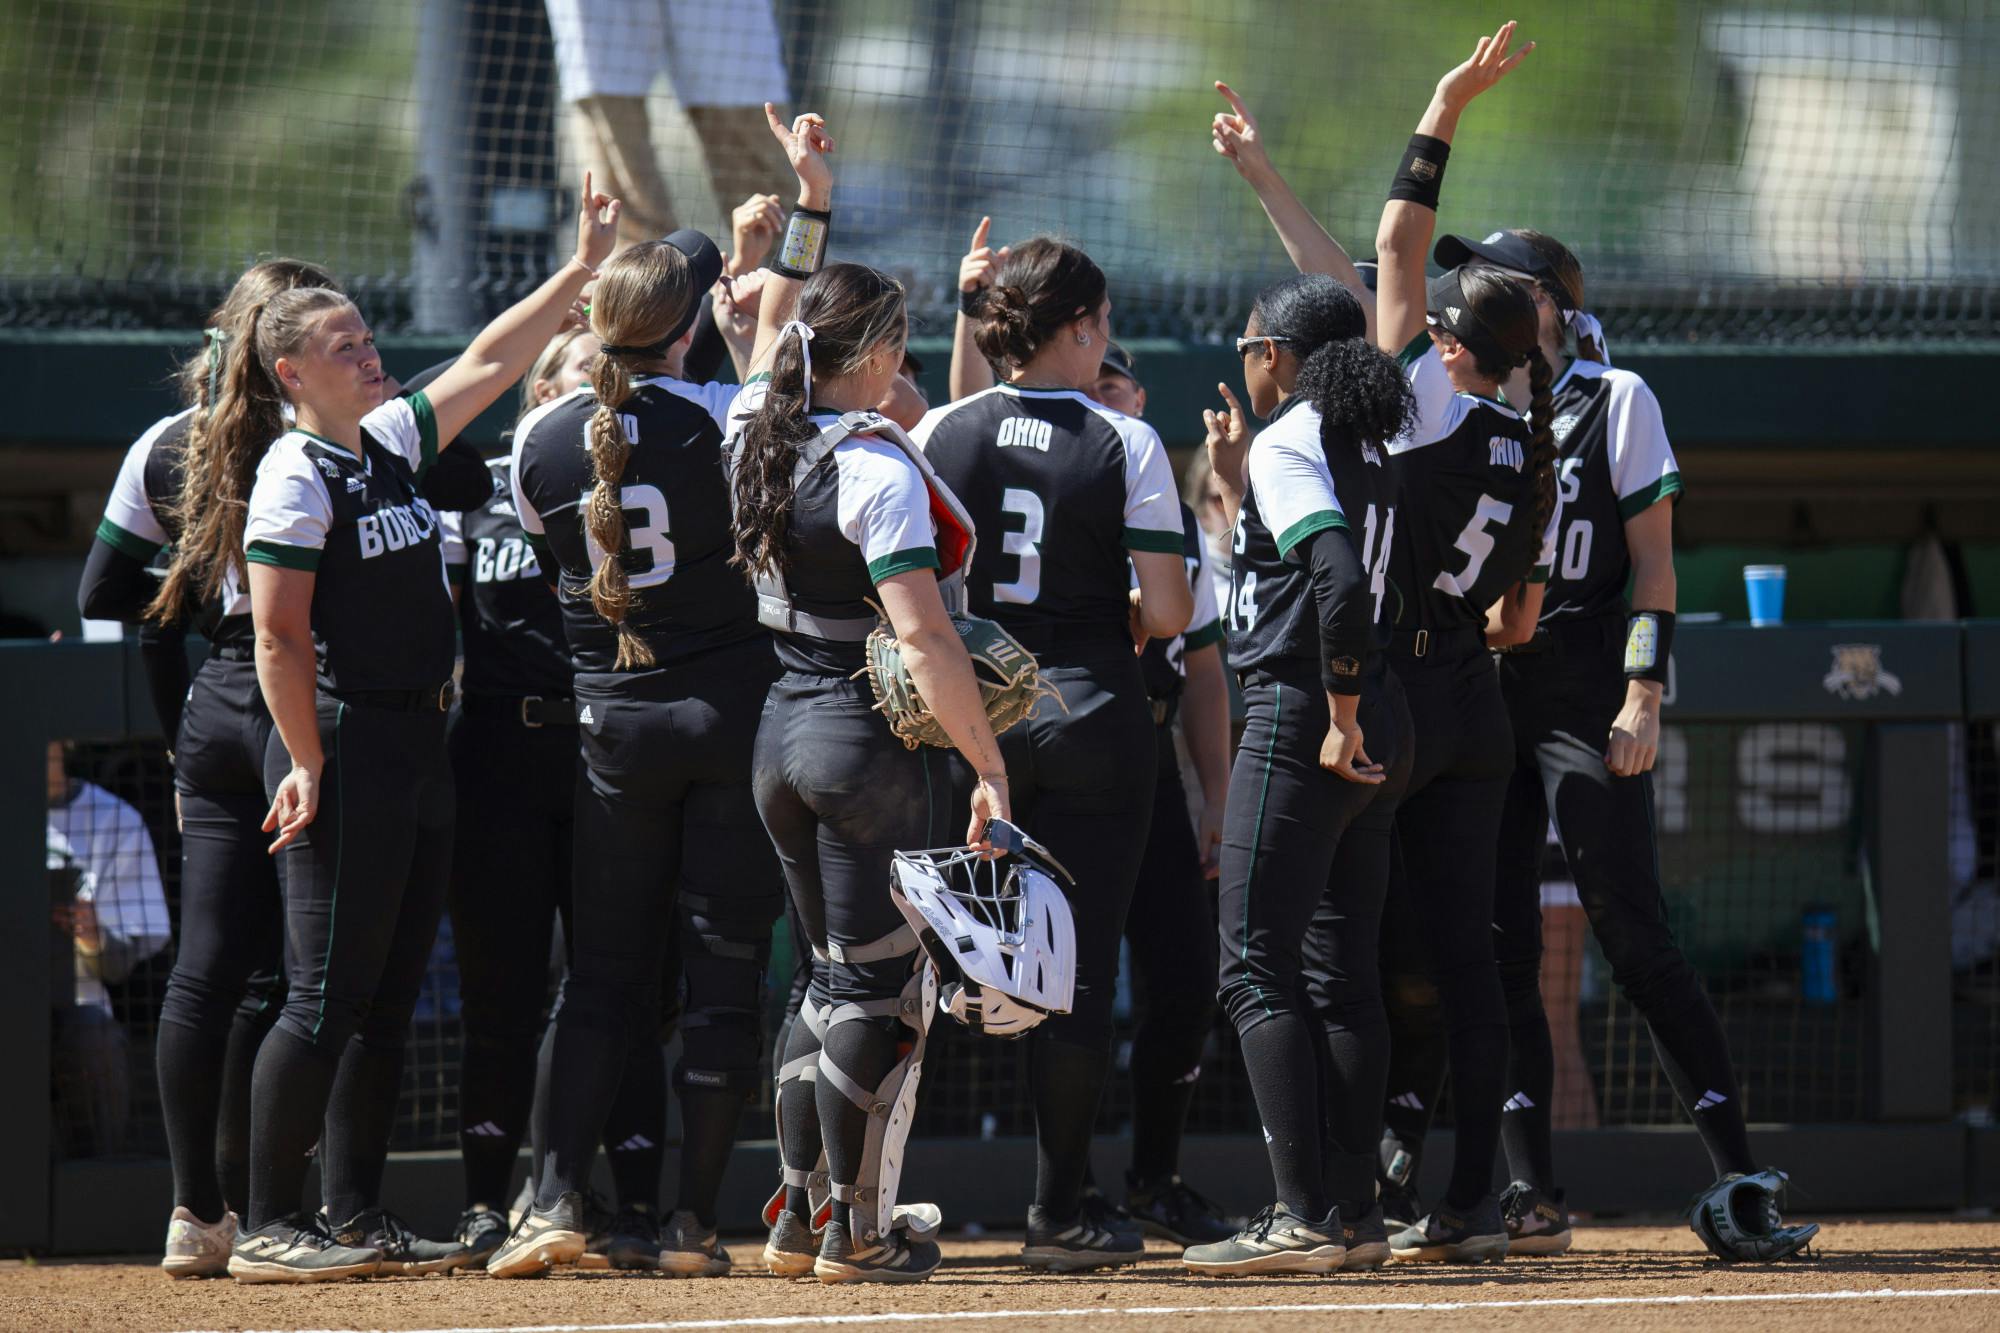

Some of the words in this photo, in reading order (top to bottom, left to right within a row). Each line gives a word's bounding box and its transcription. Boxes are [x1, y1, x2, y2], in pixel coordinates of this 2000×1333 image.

[996, 416, 1053, 452] OHIO
[357, 496, 436, 560] BOBC
[993, 488, 1044, 605] 3
[1362, 503, 1395, 625] 14
[1432, 493, 1514, 599] 5
[1229, 569, 1259, 633] 14
